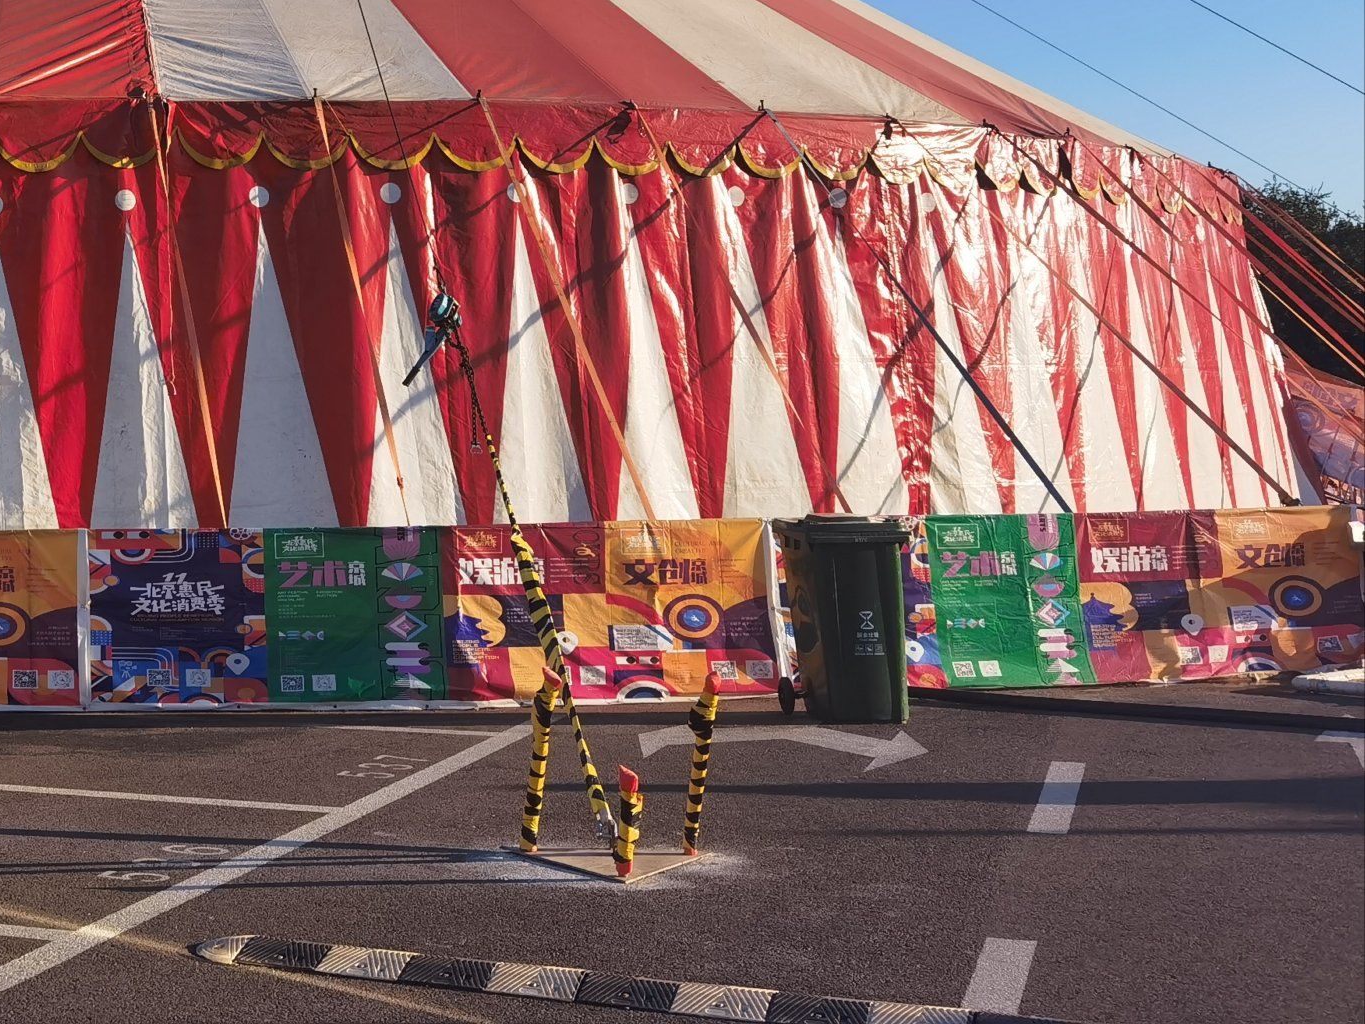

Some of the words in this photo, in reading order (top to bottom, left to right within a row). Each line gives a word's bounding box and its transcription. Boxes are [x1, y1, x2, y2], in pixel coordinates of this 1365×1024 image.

[130, 581, 225, 599] 北京惠民
[130, 594, 225, 615] 文化消费季
